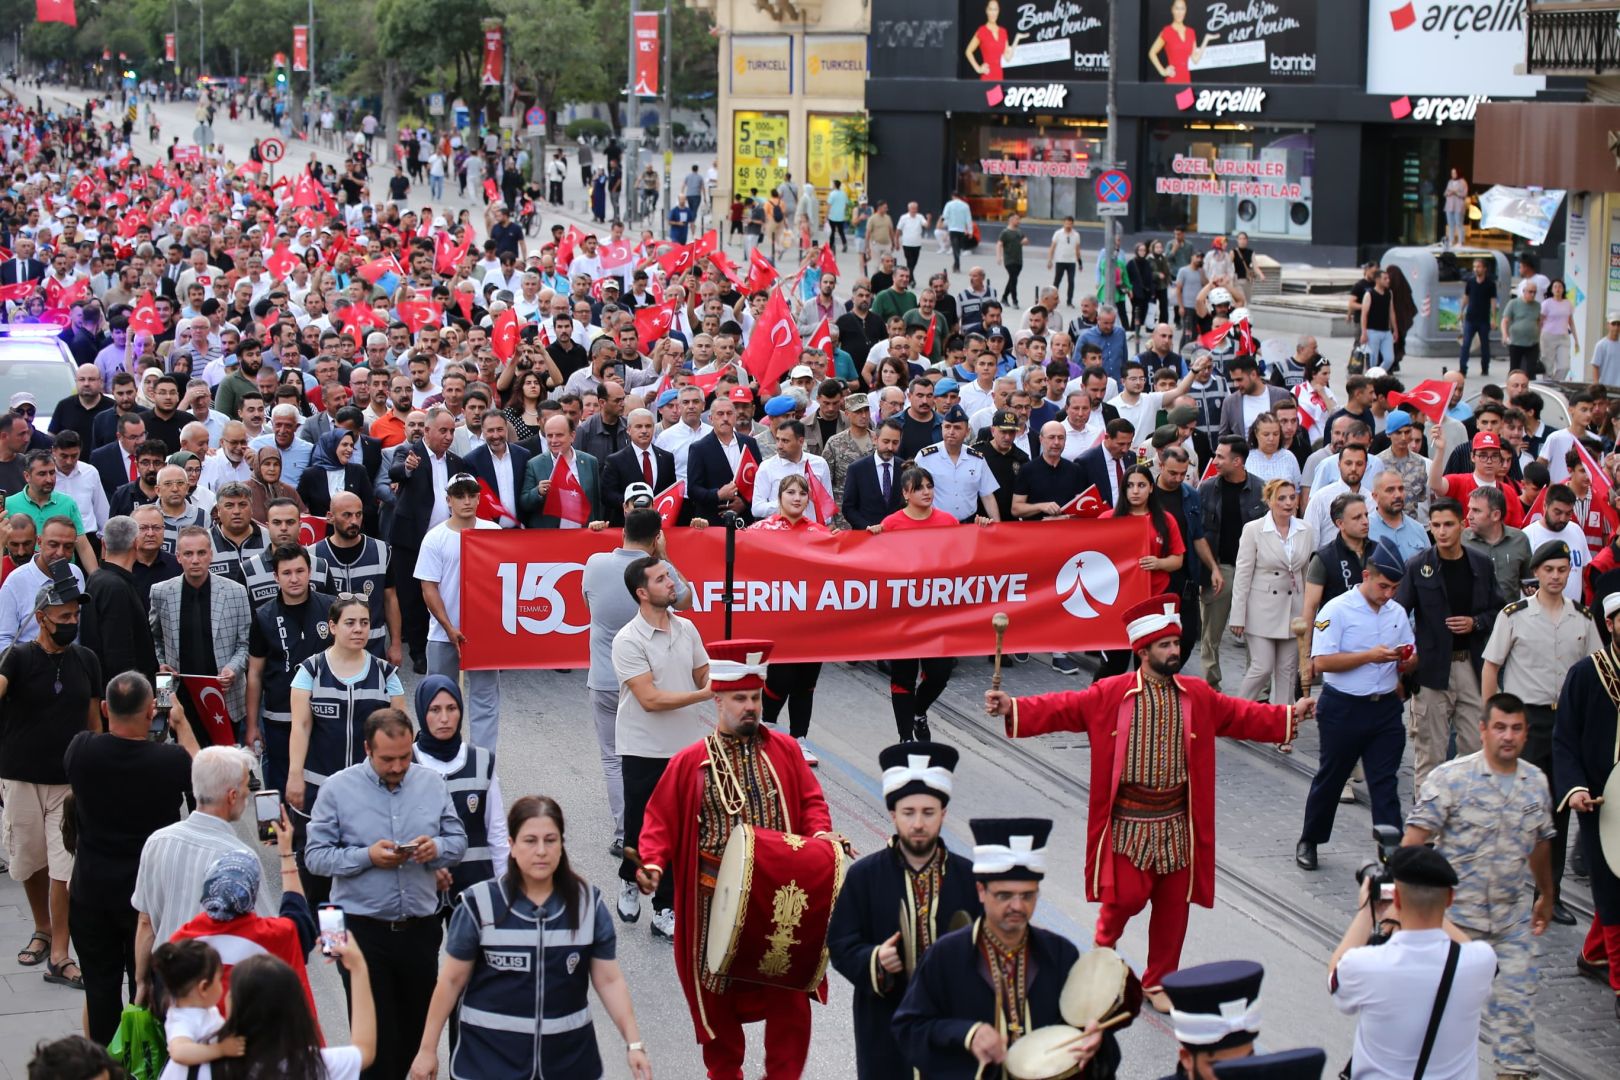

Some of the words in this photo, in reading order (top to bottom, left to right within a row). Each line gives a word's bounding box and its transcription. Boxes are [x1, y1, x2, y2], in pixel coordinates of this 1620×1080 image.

[1422, 0, 1526, 39] arçelik
[1036, 24, 1061, 41] var
[1227, 25, 1252, 43] var
[747, 60, 787, 71] TURKCELL
[821, 60, 863, 71] TURKCELL
[1074, 50, 1110, 67] bamb
[1270, 53, 1316, 71] bambi
[1004, 84, 1067, 112] arçelik
[1196, 87, 1266, 116] arçelik
[1412, 94, 1491, 126] arçeli
[740, 121, 751, 142] 5
[739, 145, 751, 154] GB
[1173, 154, 1211, 173] ÖZEL
[738, 168, 749, 179] 48
[755, 168, 767, 179] 60
[674, 580, 807, 612] AFERİN
[815, 579, 878, 611] ADI
[886, 573, 1029, 609] TÜRKİYE
[519, 605, 549, 613] TEMMUZ
